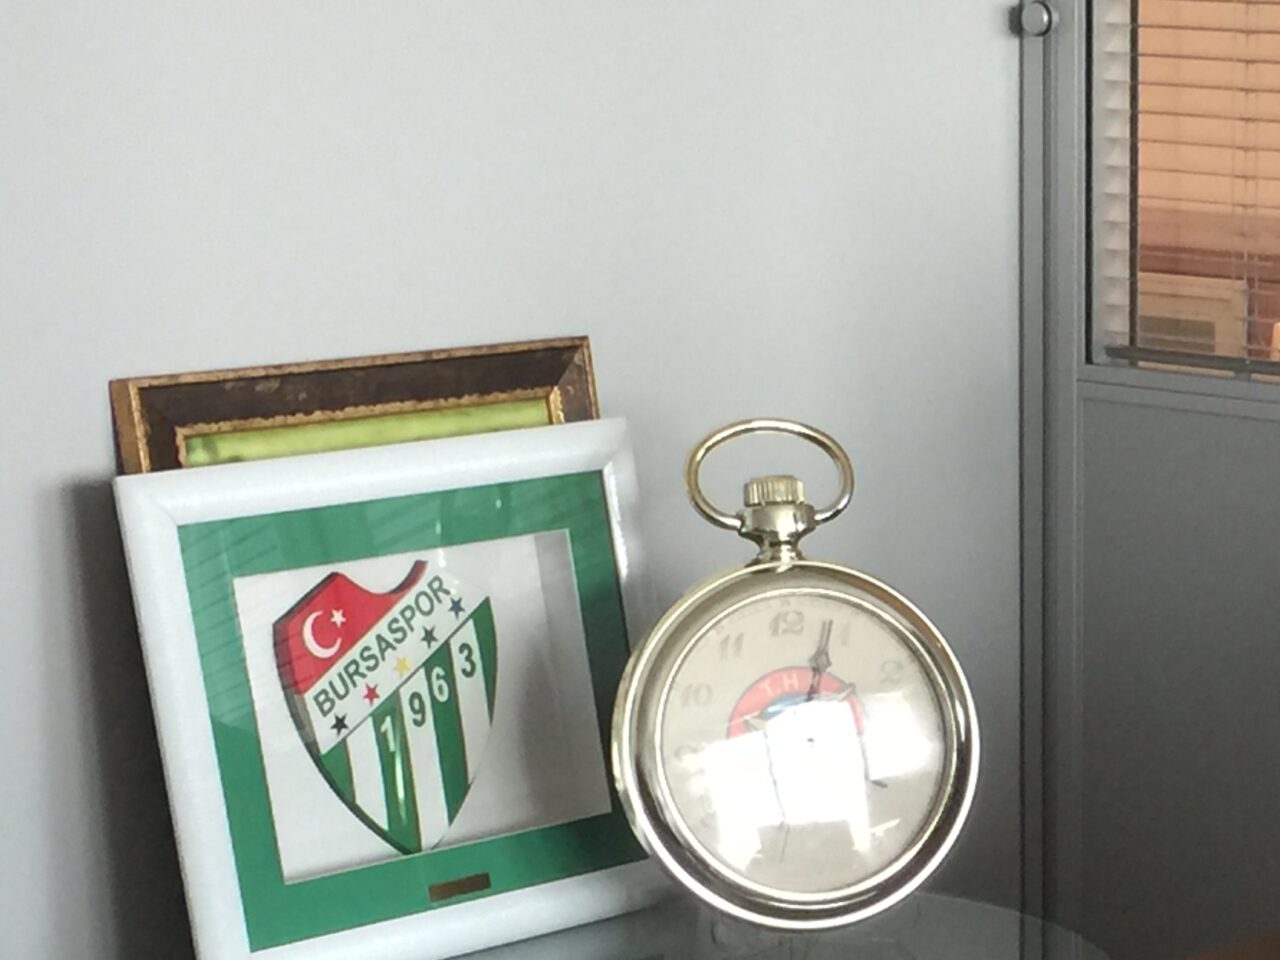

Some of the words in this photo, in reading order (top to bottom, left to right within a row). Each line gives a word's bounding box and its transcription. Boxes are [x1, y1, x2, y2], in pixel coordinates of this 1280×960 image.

[312, 574, 452, 717] BURSASPOR
[769, 610, 805, 637] 12
[380, 642, 478, 753] 1963
